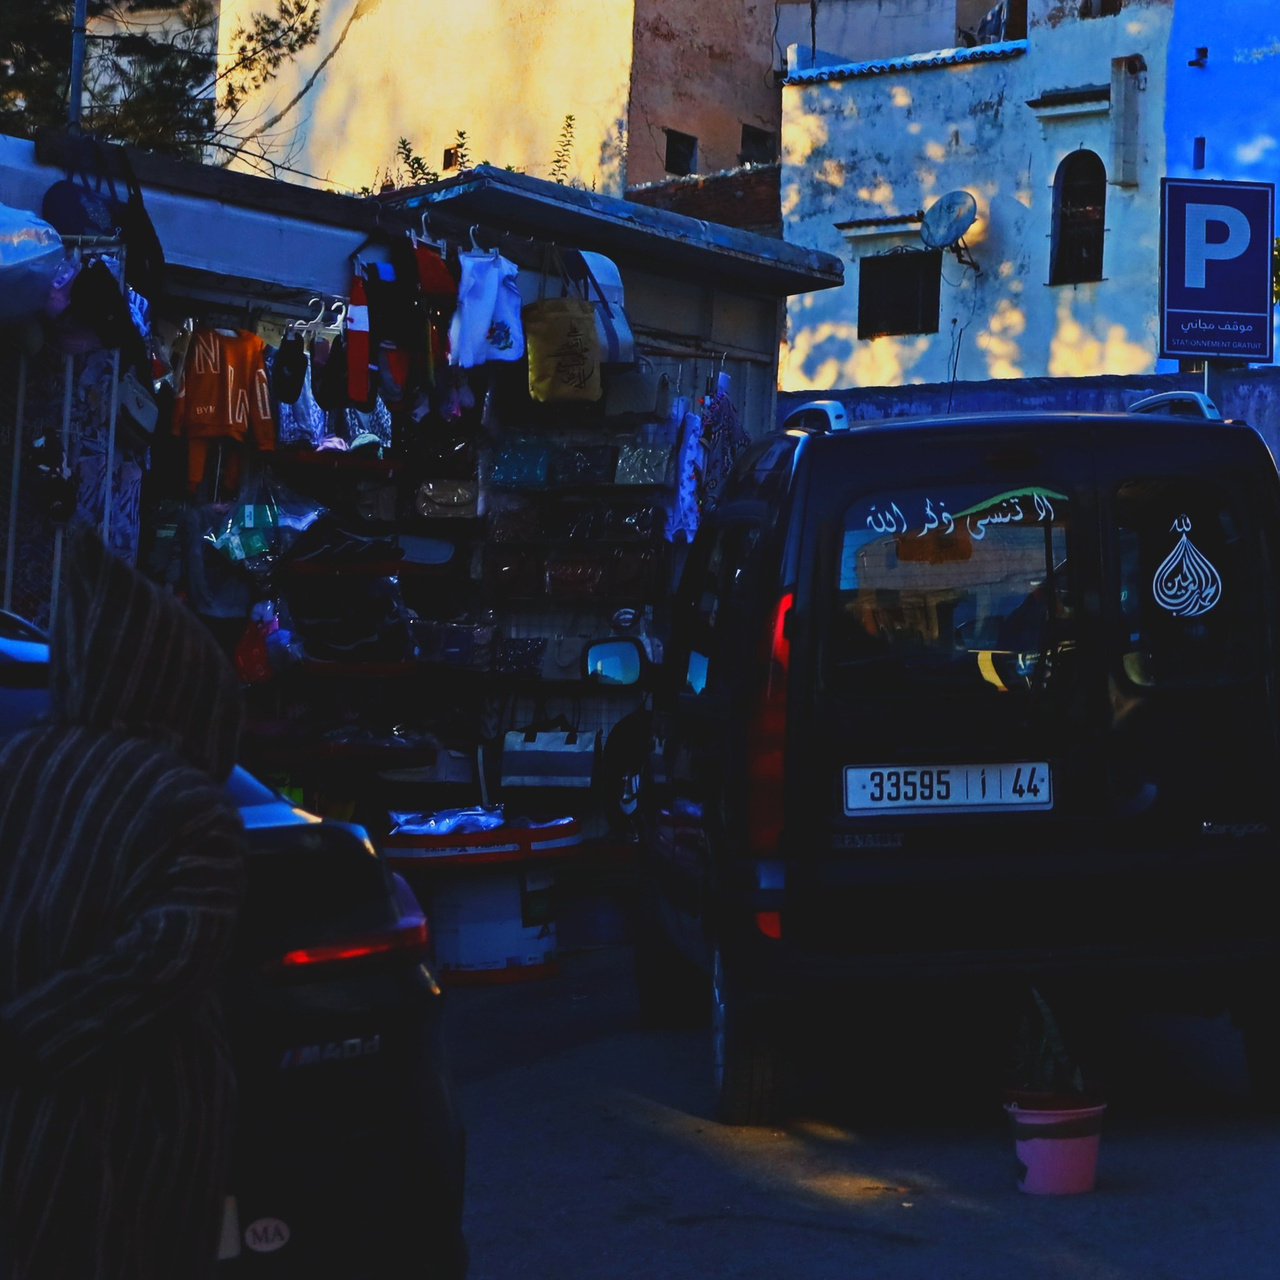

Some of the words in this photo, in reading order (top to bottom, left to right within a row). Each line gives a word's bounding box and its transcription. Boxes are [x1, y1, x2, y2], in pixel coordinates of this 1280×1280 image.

[1184, 202, 1252, 289] P
[1181, 318, 1215, 334] مجاني
[1217, 320, 1253, 334] موقف
[1171, 337, 1231, 348] STATONNEMENT
[1232, 340, 1262, 350] GRATUIT
[866, 501, 908, 534] الله
[869, 770, 951, 802] 33595
[1012, 767, 1040, 798] 44
[250, 1224, 286, 1246] MA
